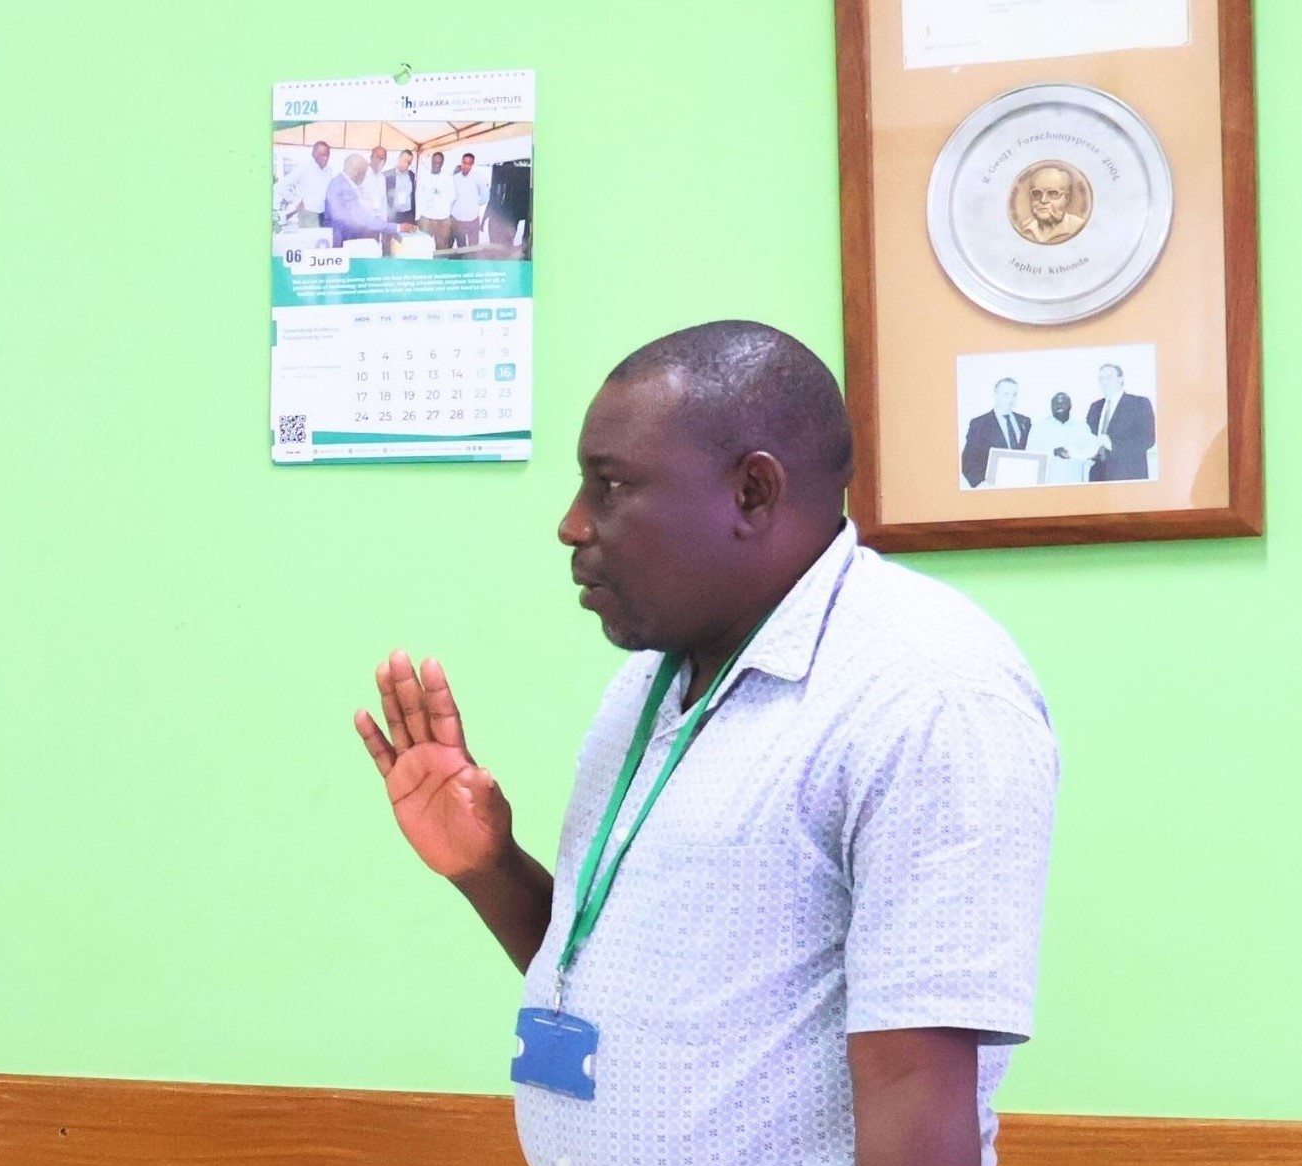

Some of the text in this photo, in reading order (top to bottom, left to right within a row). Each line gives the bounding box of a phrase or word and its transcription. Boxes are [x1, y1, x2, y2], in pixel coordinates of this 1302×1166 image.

[284, 100, 318, 116] 2024
[286, 249, 343, 268] 06 June
[502, 327, 509, 336] 2
[359, 351, 366, 362] 3
[382, 352, 389, 360] 4
[406, 351, 413, 359] 5
[430, 350, 437, 359] 6
[453, 349, 461, 358] 7
[501, 348, 509, 357] 9
[356, 367, 511, 381] 10 11 12 13 14 15 16
[357, 388, 511, 401] 17 18 19 20 21 22 23
[355, 409, 512, 422] 24 25 26 27 28 29 30
